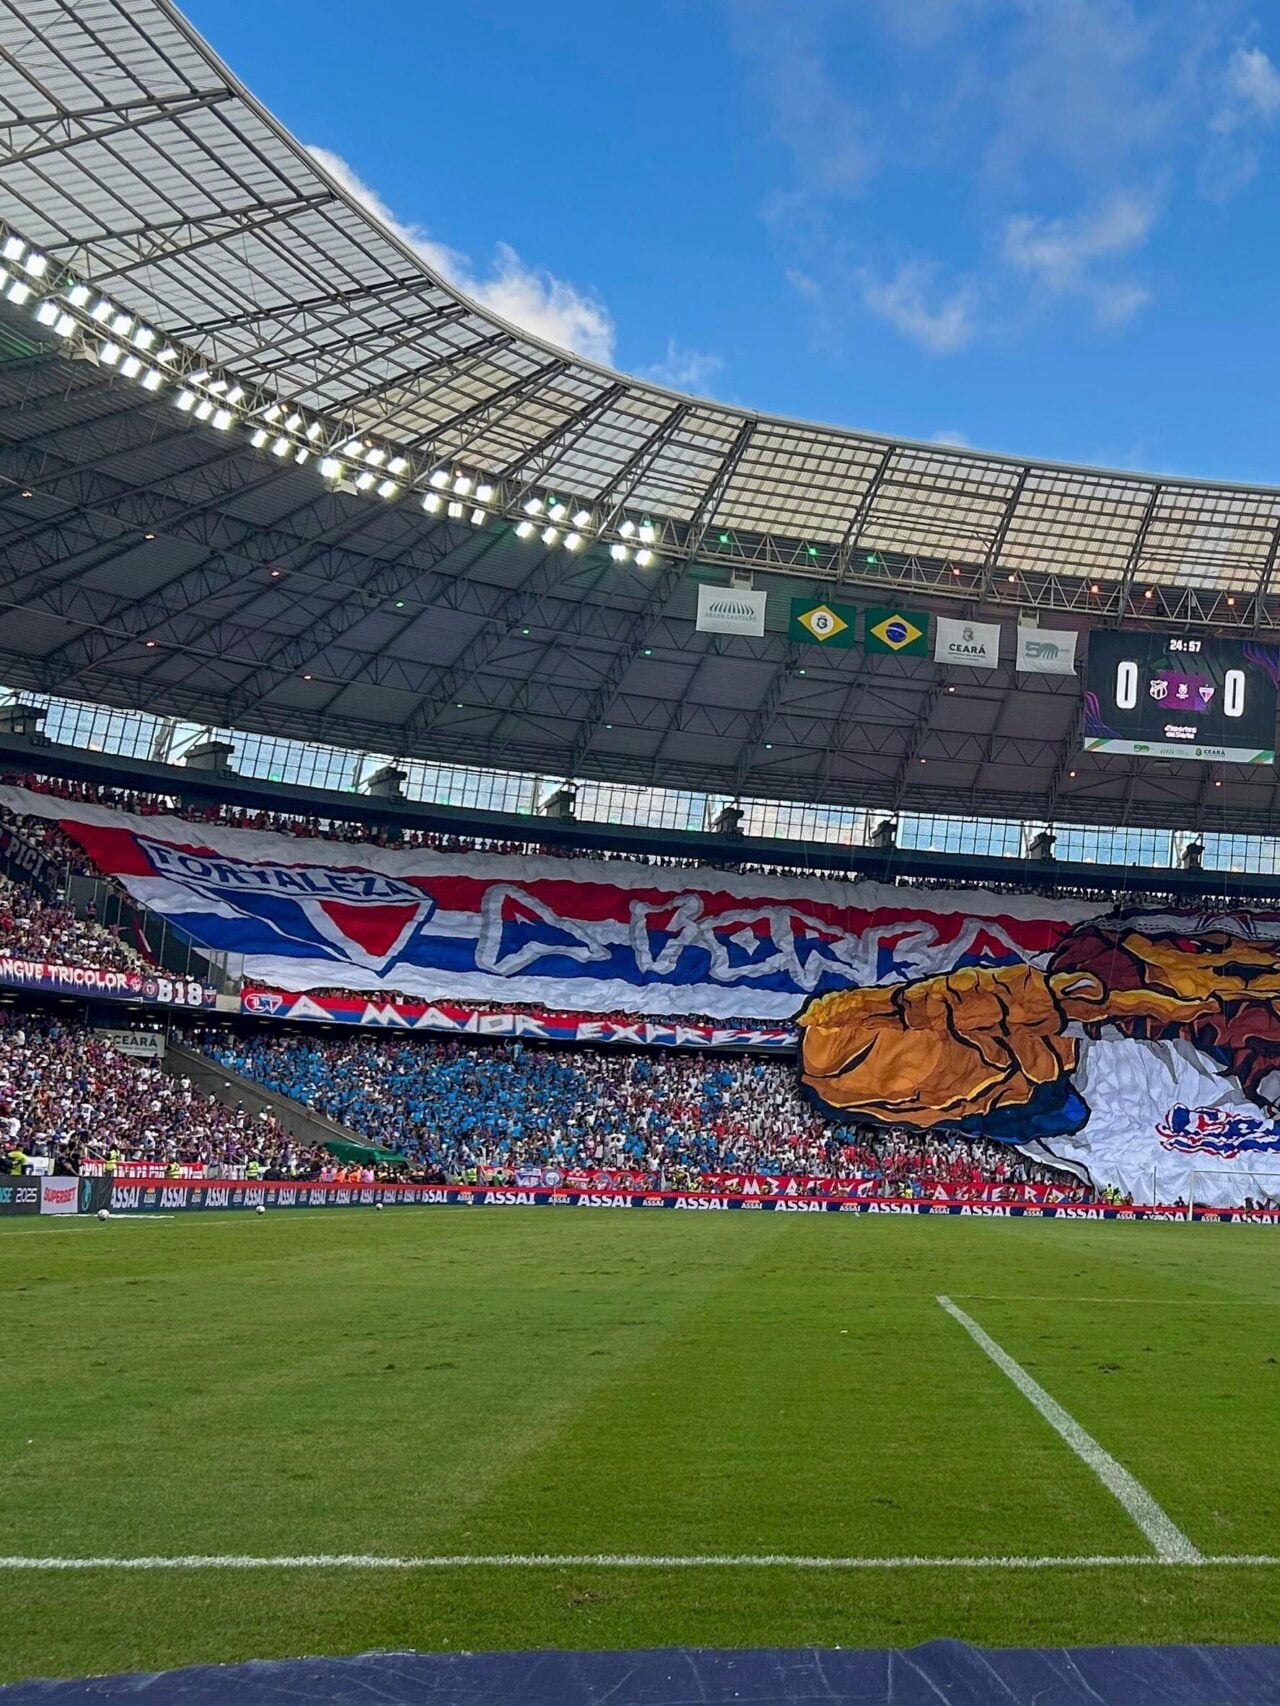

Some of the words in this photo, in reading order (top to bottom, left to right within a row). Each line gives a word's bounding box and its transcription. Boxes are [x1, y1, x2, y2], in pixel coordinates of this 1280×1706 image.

[949, 643, 986, 655] CEARÁ
[1116, 661, 1138, 709] 0
[1224, 669, 1245, 717] 0
[154, 846, 414, 897] FORTALEZA
[0, 958, 43, 984] NGUE
[48, 965, 129, 993] TRICOLOR
[157, 978, 202, 1006] B18
[285, 995, 335, 1020] A
[113, 1034, 158, 1048] CEARÁ
[16, 1187, 38, 1203] 2025
